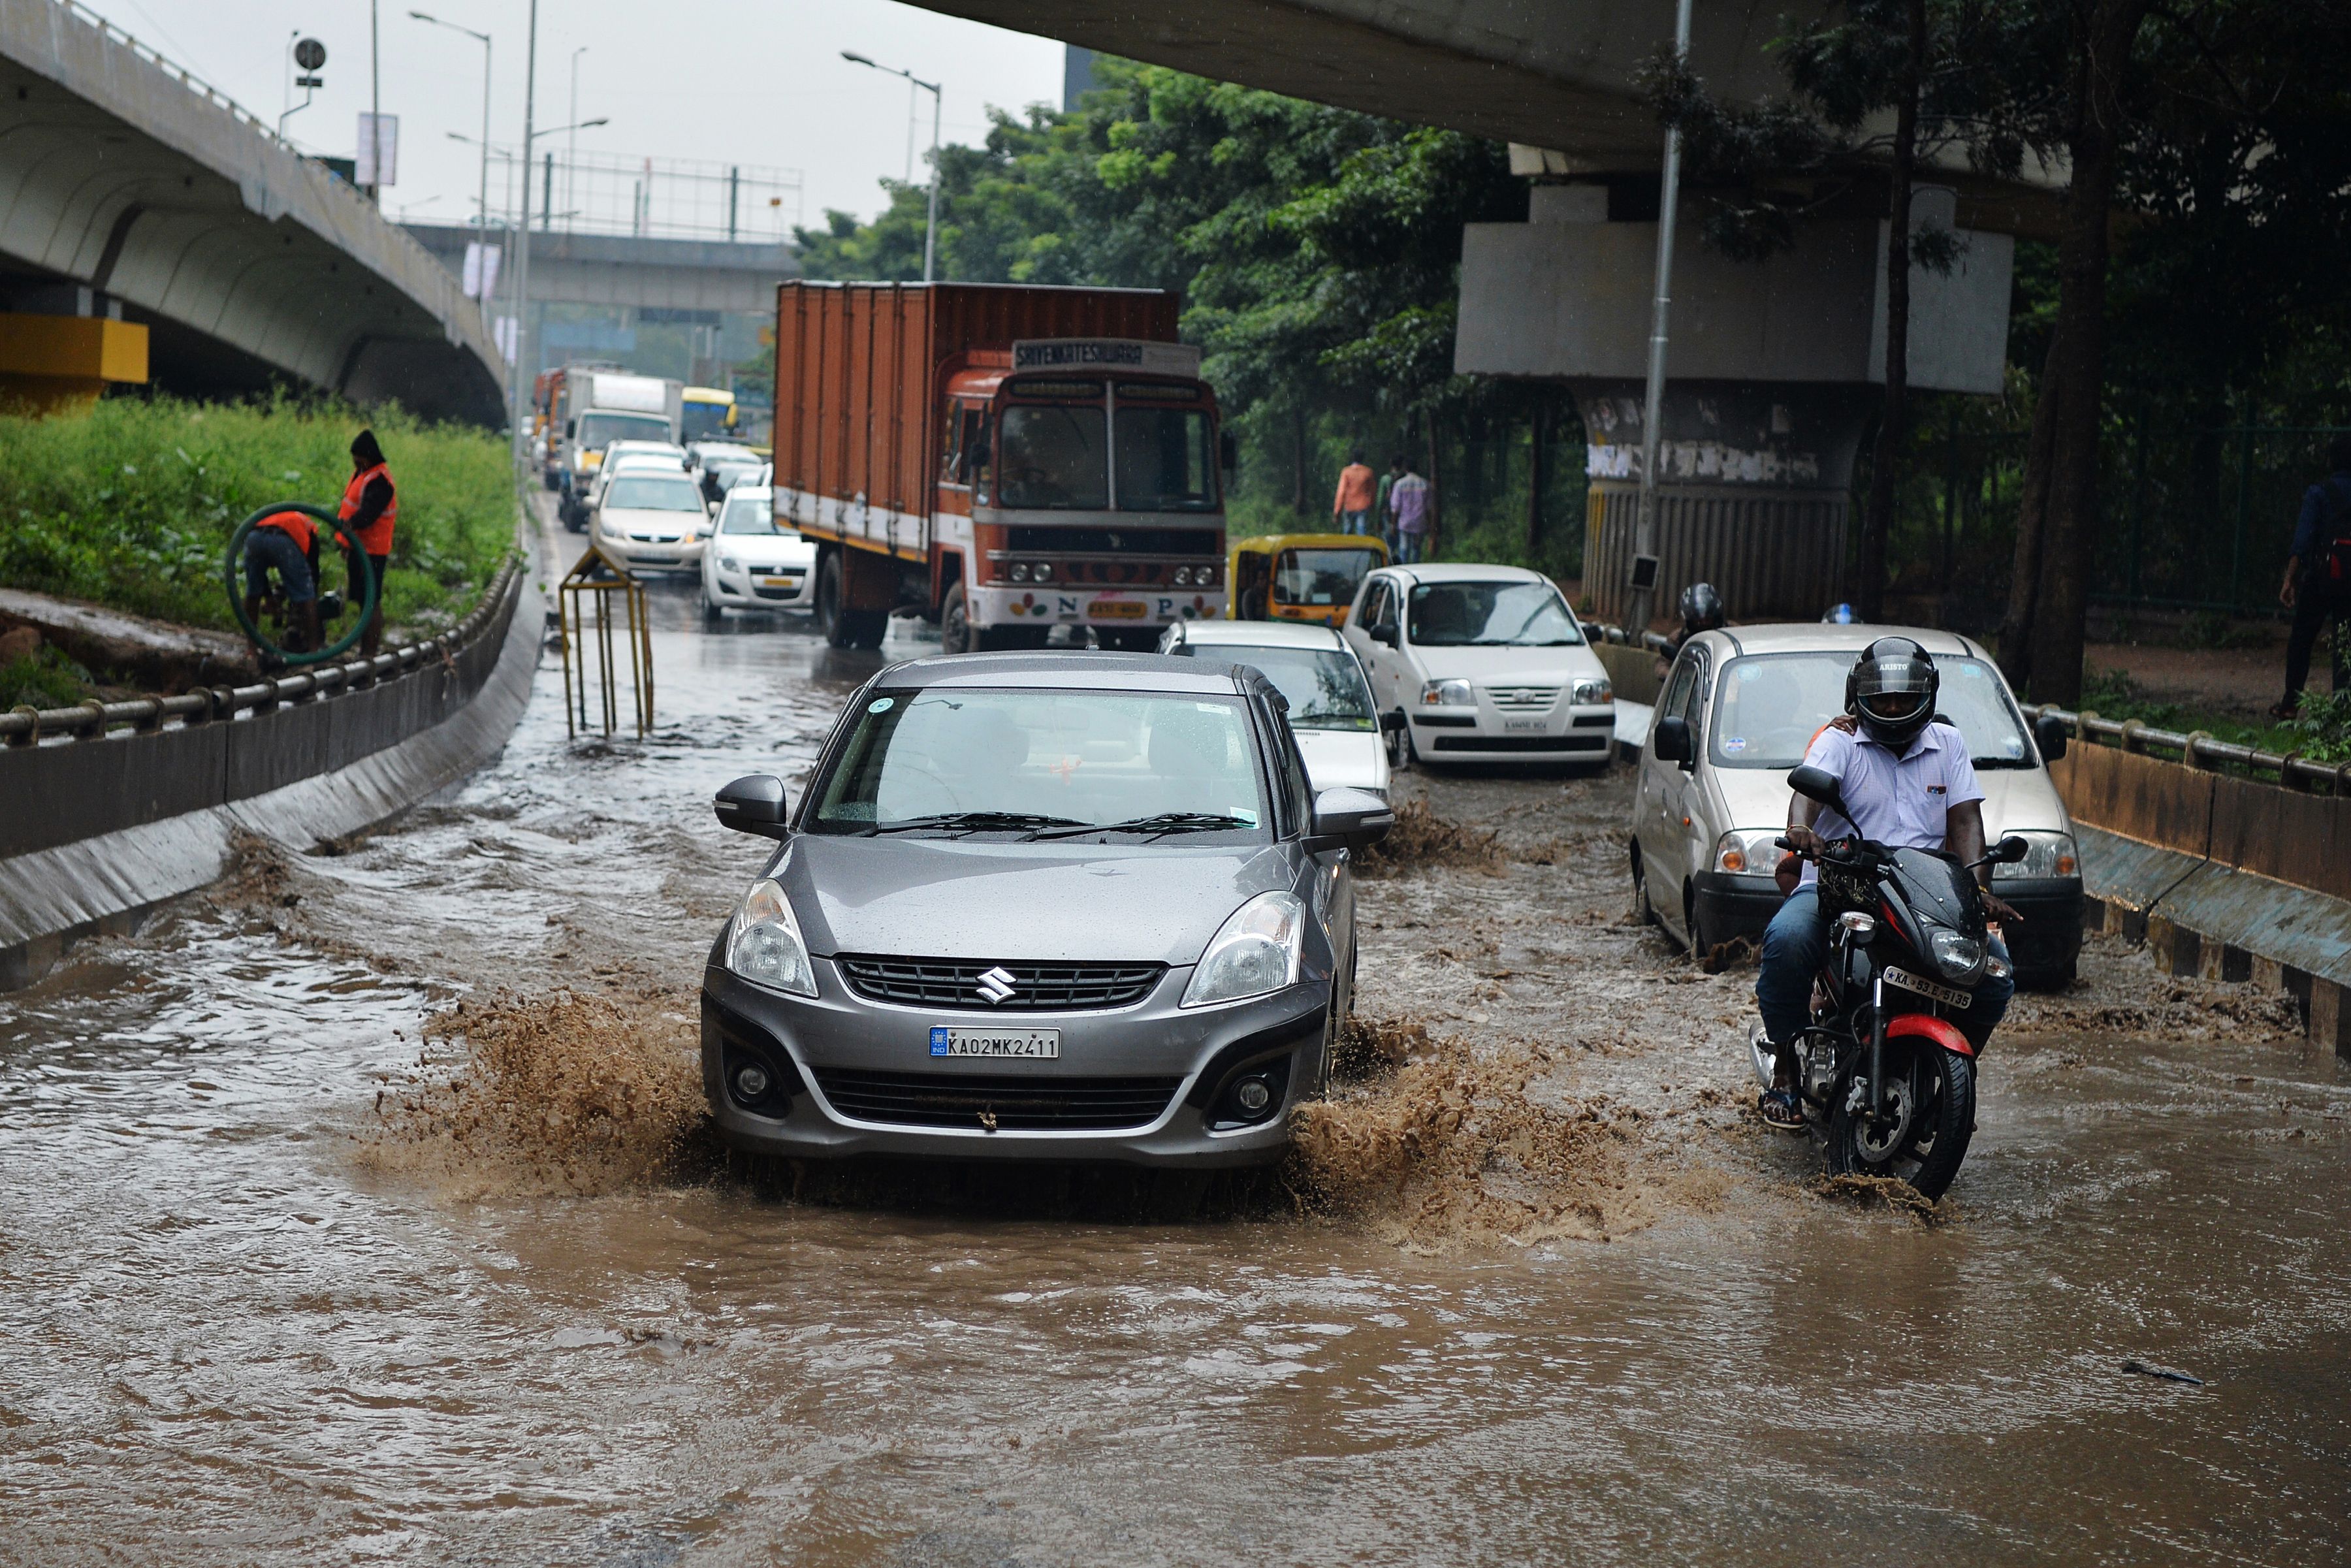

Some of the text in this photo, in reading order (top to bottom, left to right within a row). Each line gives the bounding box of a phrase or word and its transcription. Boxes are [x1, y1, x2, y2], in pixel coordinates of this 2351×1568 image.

[1058, 597, 1076, 612] N
[1158, 598, 1172, 613] P
[948, 1038, 1055, 1055] KA02MK2411
